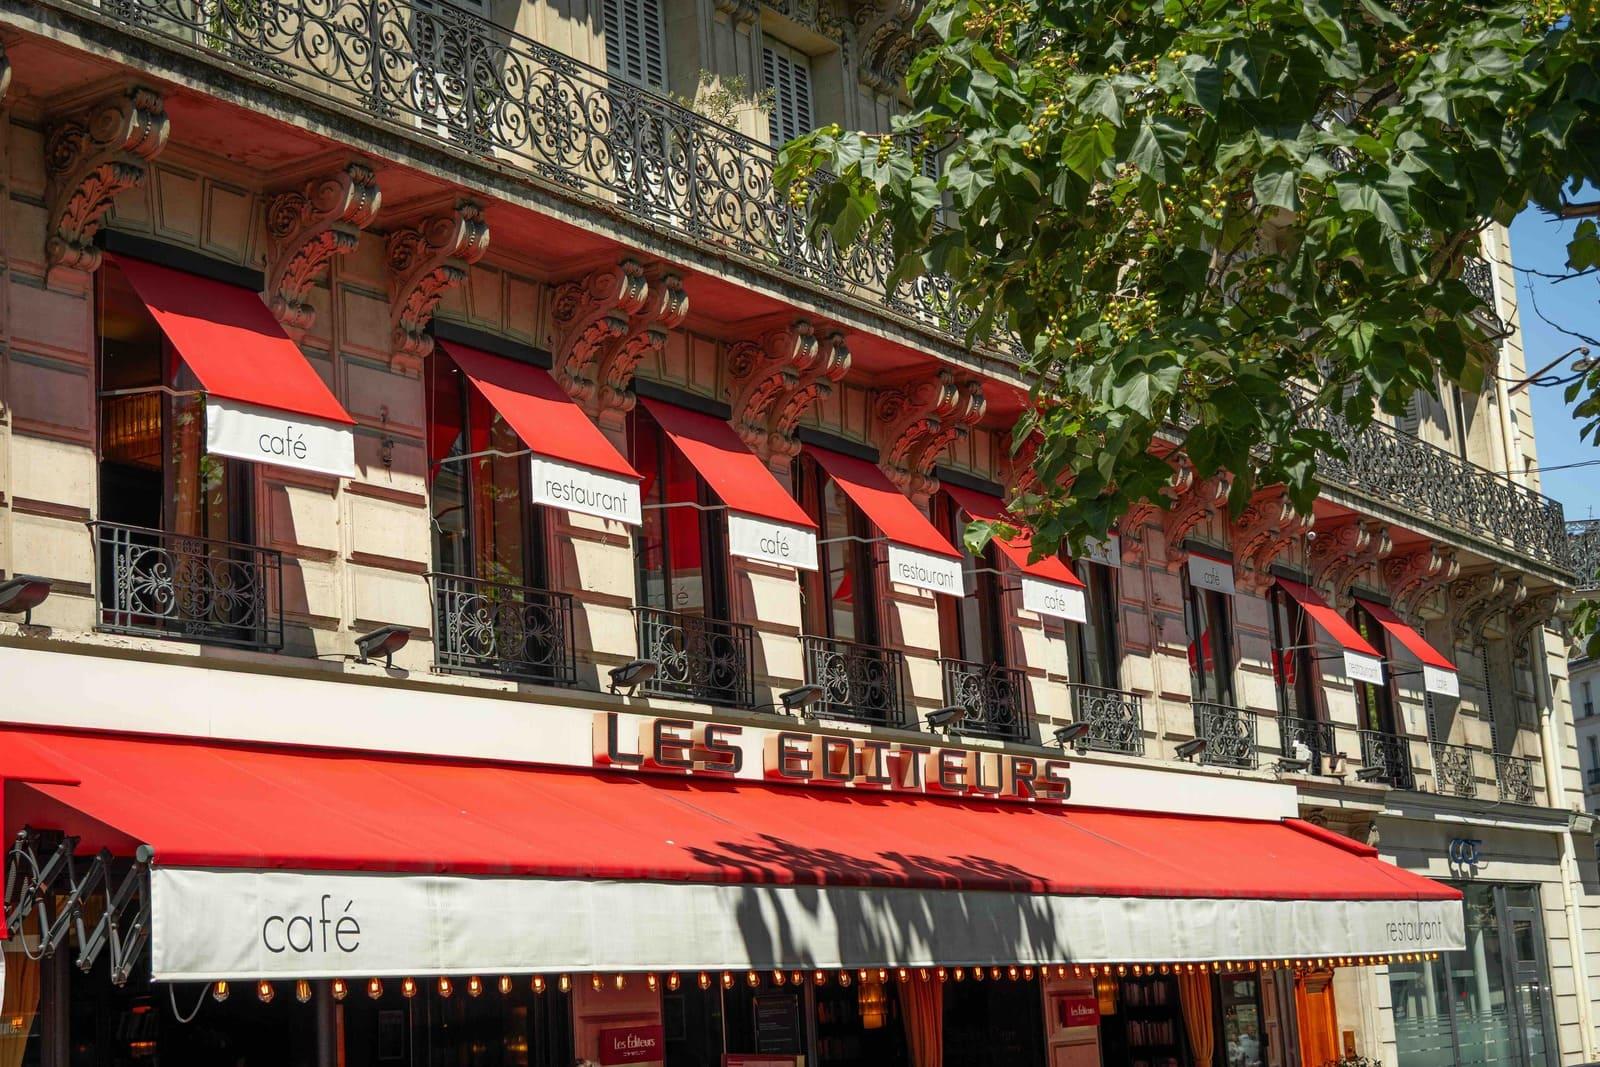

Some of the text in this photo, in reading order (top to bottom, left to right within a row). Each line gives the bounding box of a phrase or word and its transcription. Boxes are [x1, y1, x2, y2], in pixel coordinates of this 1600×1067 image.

[259, 426, 307, 459] café
[546, 479, 628, 514] restaurant
[760, 530, 790, 557] café
[898, 562, 954, 590] restaurant
[1044, 589, 1065, 612] café
[606, 712, 1071, 800] LES EDITEURS
[263, 894, 361, 953] café
[1386, 915, 1442, 943] restaurant
